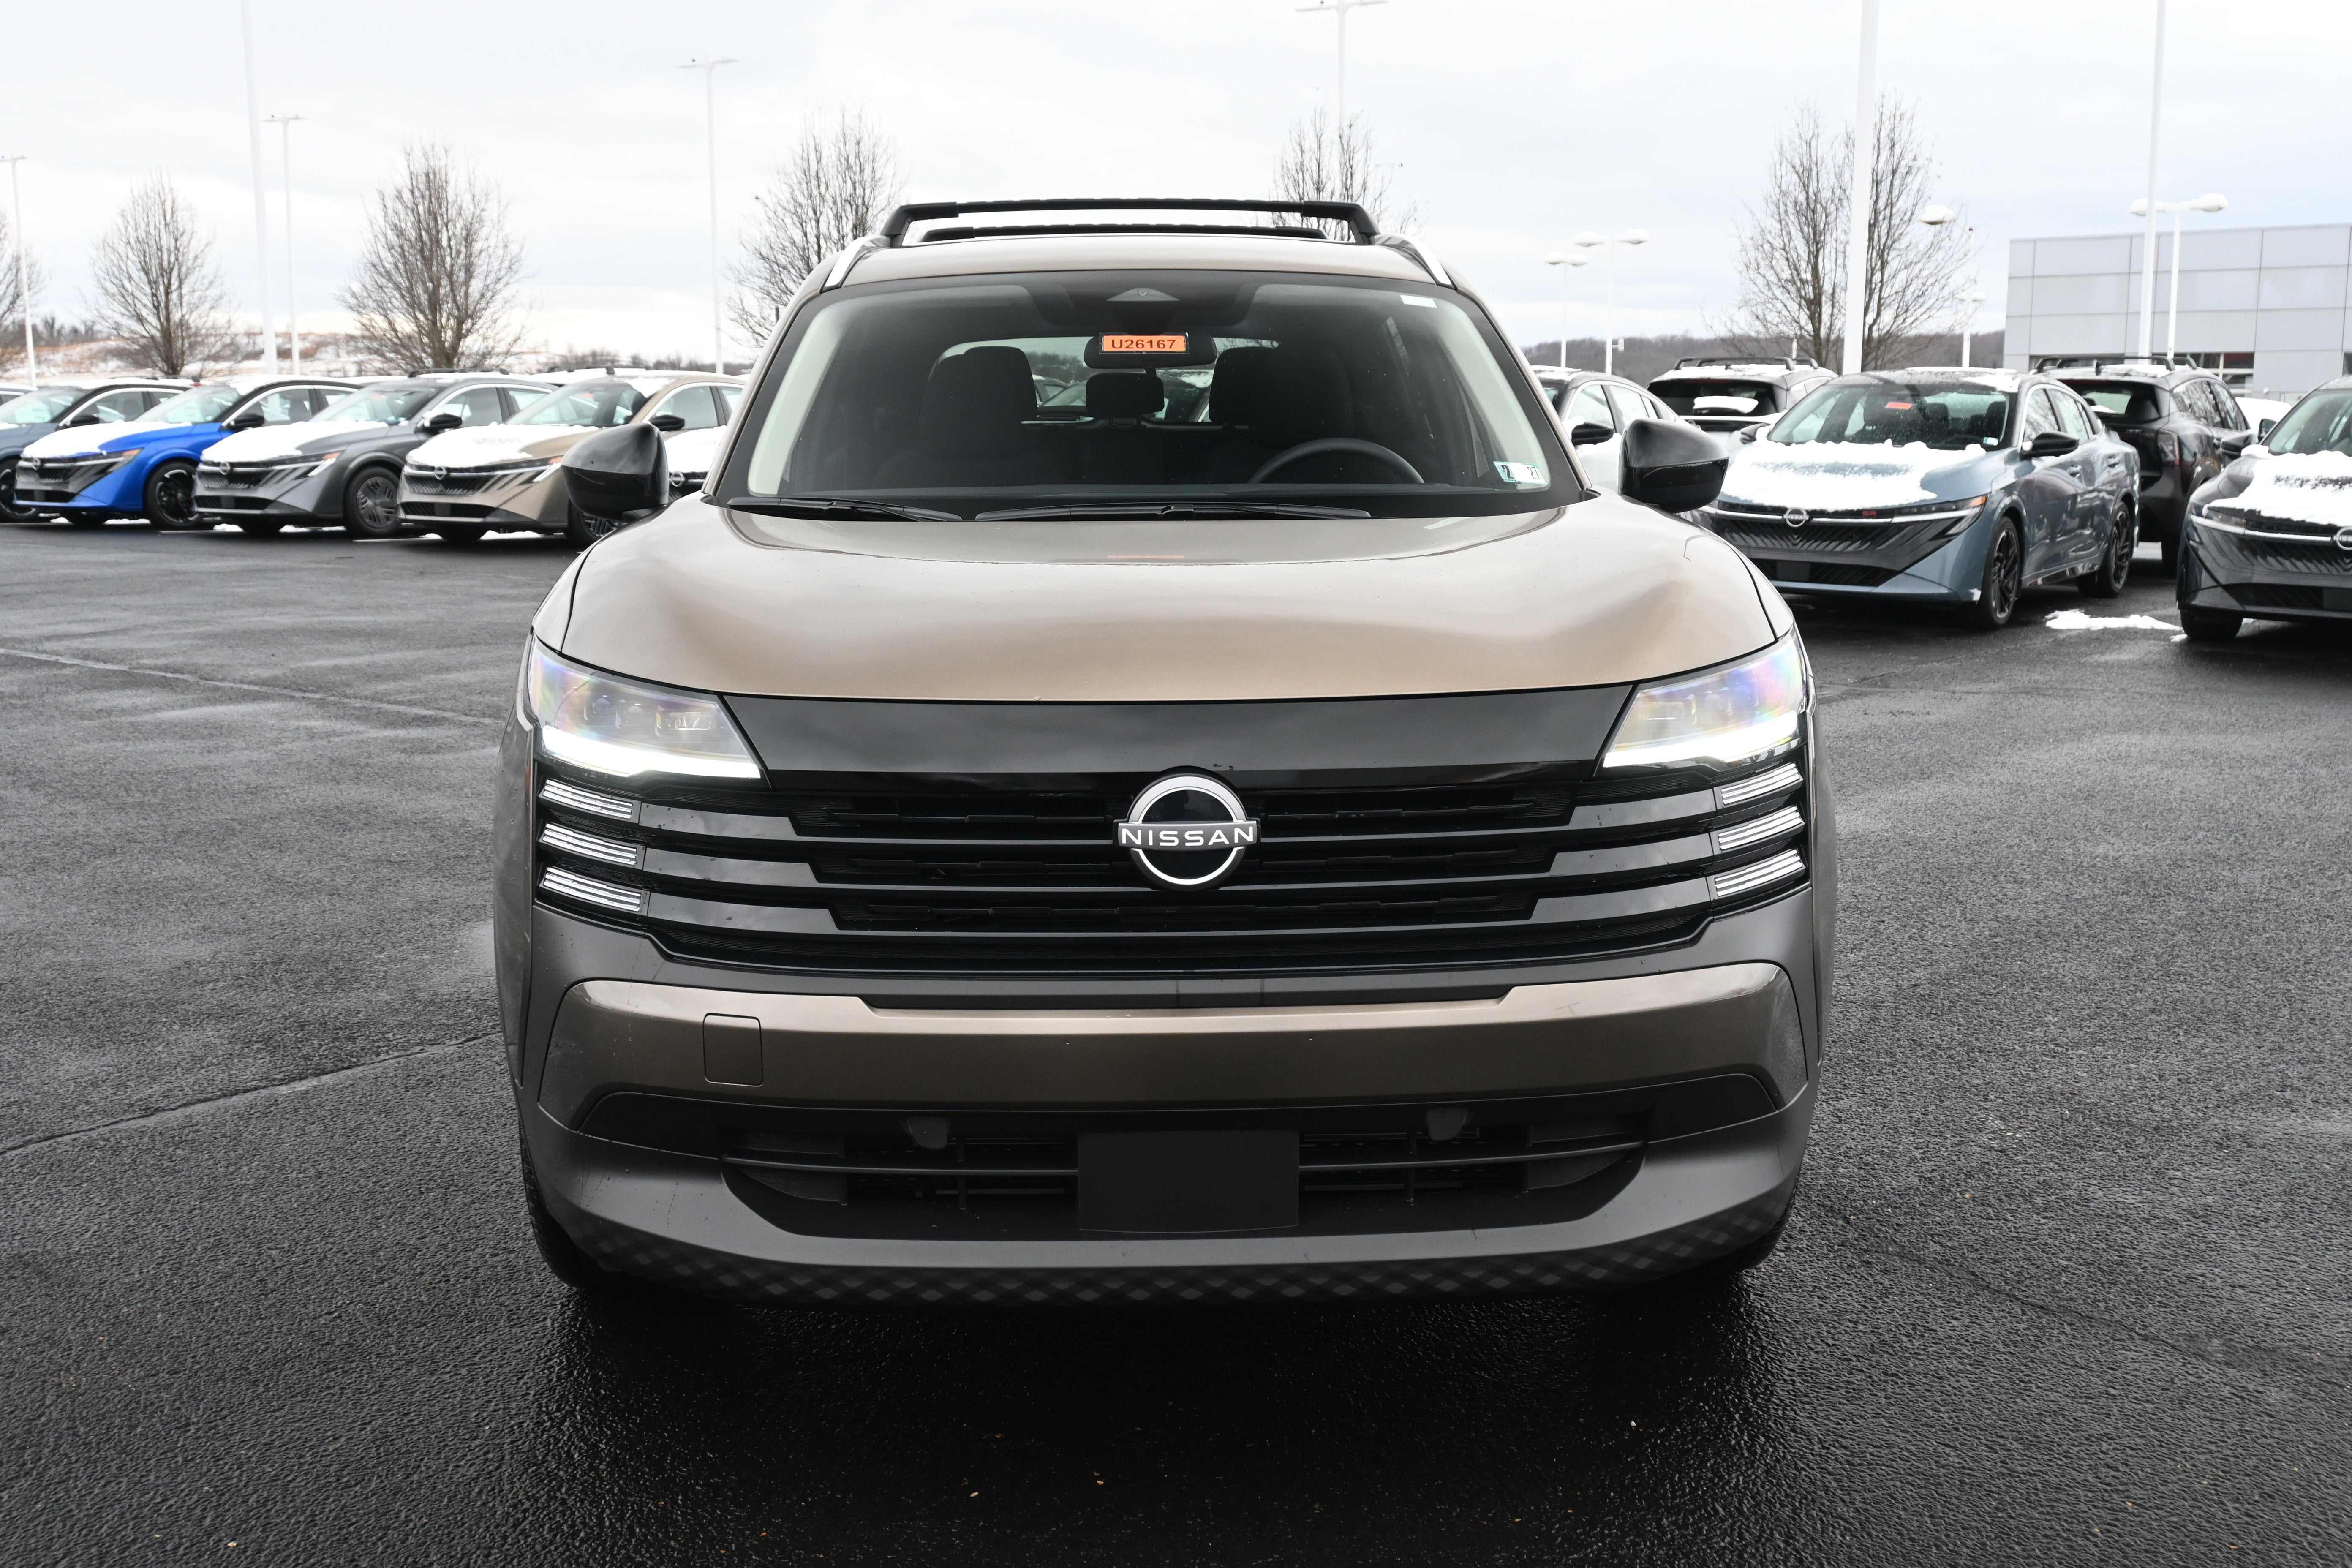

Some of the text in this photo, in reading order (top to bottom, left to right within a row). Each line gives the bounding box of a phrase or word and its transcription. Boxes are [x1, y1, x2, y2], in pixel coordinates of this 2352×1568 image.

[1111, 339, 1176, 349] U26167
[1527, 466, 1540, 480] 27
[1122, 826, 1253, 846] NISSAN
